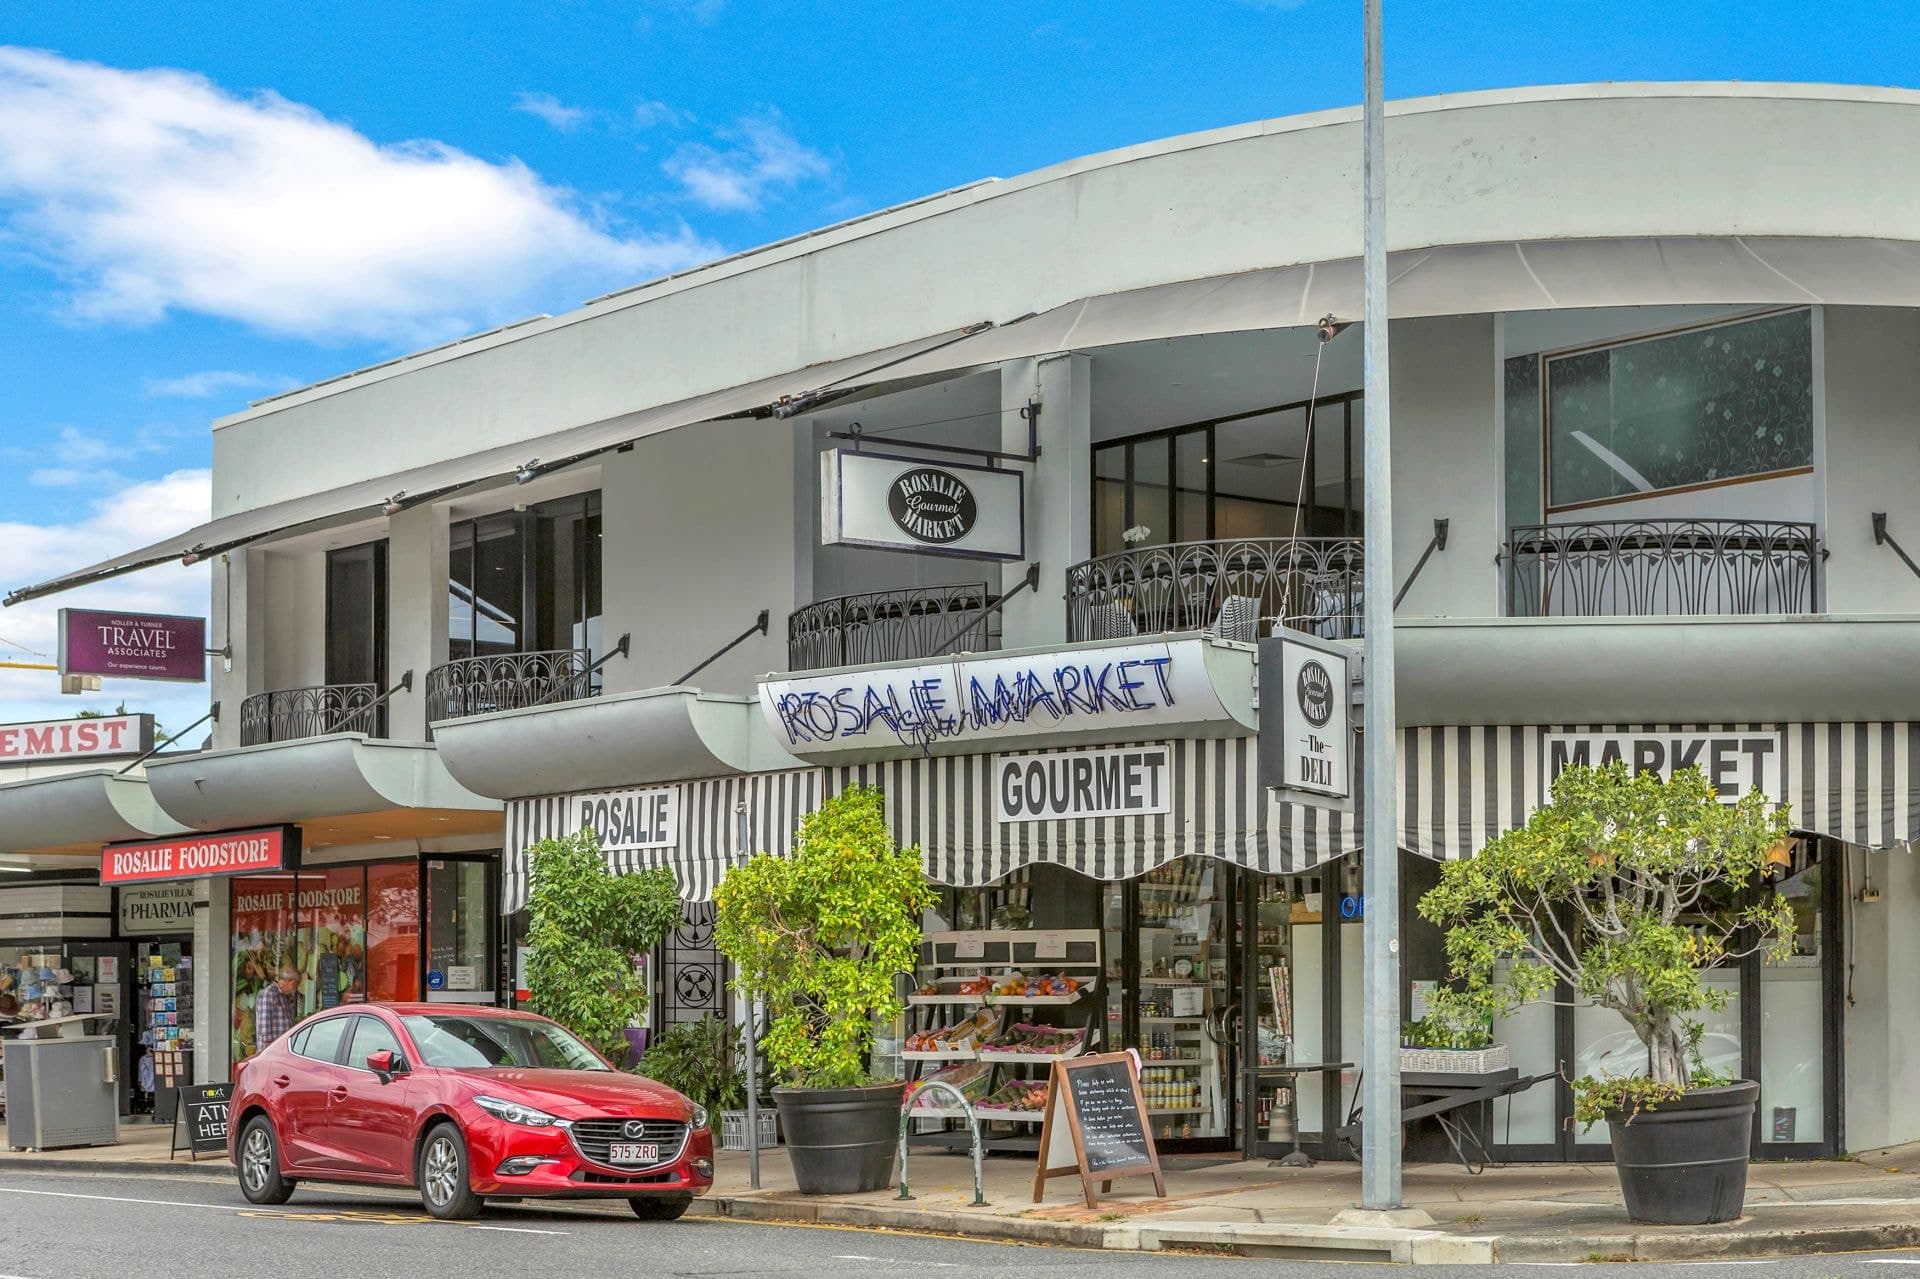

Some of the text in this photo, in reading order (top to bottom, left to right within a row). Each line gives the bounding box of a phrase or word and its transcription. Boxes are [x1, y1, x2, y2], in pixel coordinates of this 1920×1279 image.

[899, 474, 966, 503] ROSALIE
[906, 495, 960, 514] Gourmet
[901, 507, 965, 538] MARKET
[98, 626, 176, 649] TRAVEL
[108, 647, 167, 658] ASSOCIATES
[1302, 666, 1328, 692] ROSALIE
[778, 658, 1175, 745] ROSALIE MARKET
[1303, 691, 1327, 720] MARKET
[1308, 734, 1324, 753] The
[1002, 752, 1164, 816] GOURMET
[1300, 756, 1332, 786] DELI
[113, 838, 269, 875] ROSALIE FOODSTORE
[140, 889, 168, 899] ROSALIE
[237, 887, 360, 913] ROSALIE FOODSTORE
[202, 1088, 224, 1099] nxt
[611, 1145, 657, 1158] 575 ZRO
